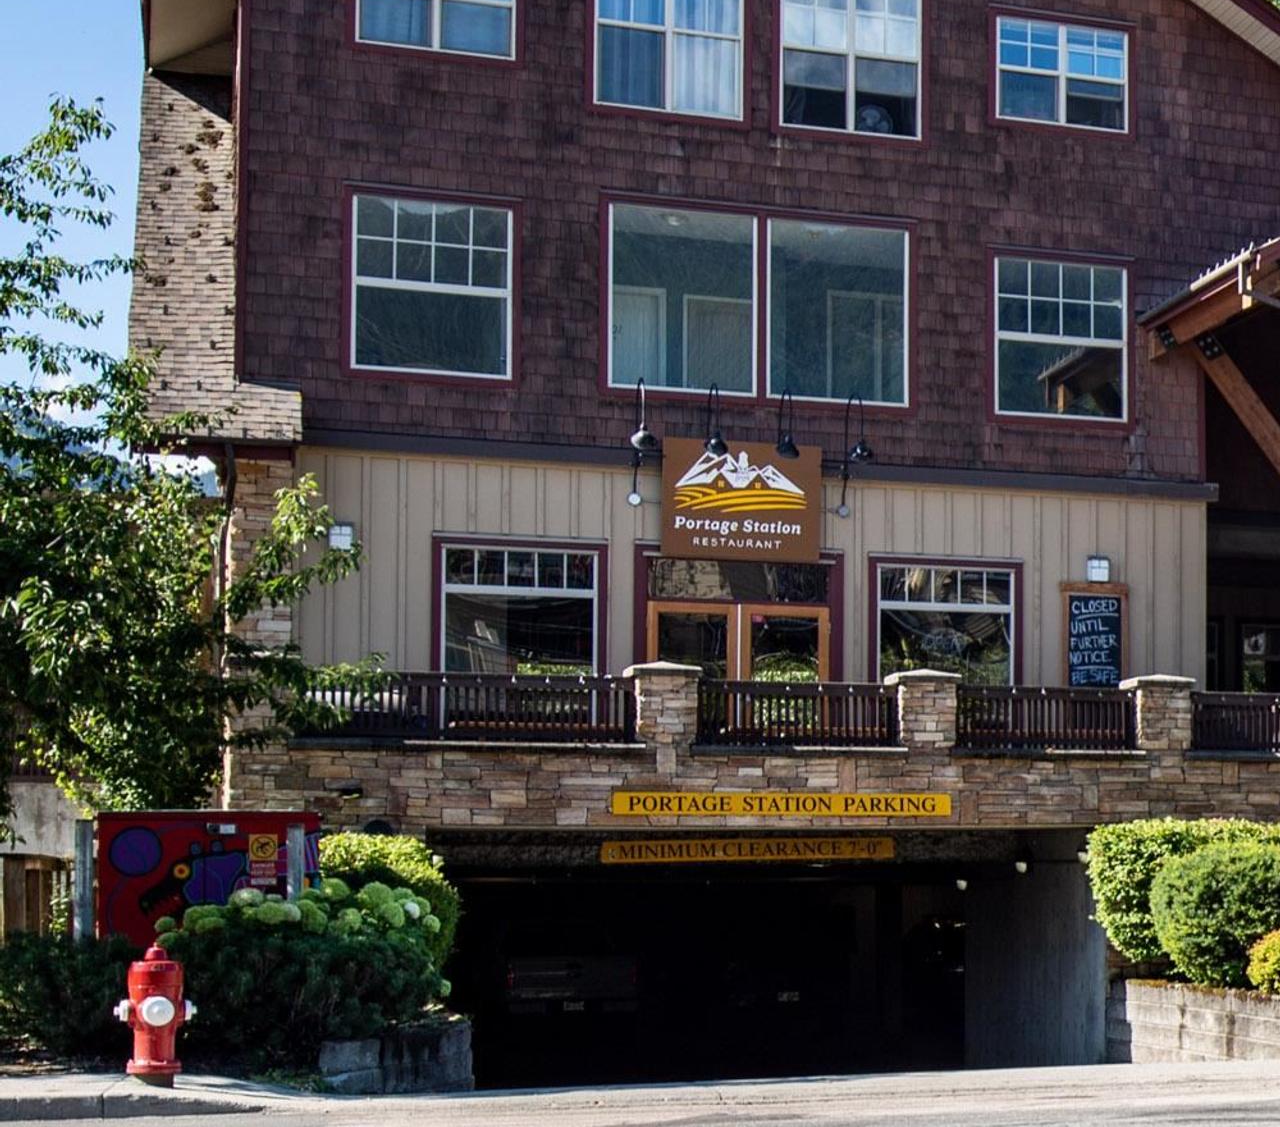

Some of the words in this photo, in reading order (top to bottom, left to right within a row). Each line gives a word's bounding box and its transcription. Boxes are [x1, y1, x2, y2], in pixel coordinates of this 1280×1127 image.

[674, 515, 738, 535] Portage
[743, 520, 801, 535] Station
[693, 537, 782, 549] RESTAURANT
[1071, 599, 1118, 614] CLOSED
[1071, 618, 1109, 634] UNTIL
[1070, 634, 1118, 650] FURTHER
[629, 796, 732, 812] PORTAGE
[742, 796, 832, 813] STATION
[843, 797, 936, 813] PARKING
[620, 842, 716, 859] MINIMUM
[722, 840, 841, 858] CLEARANCE
